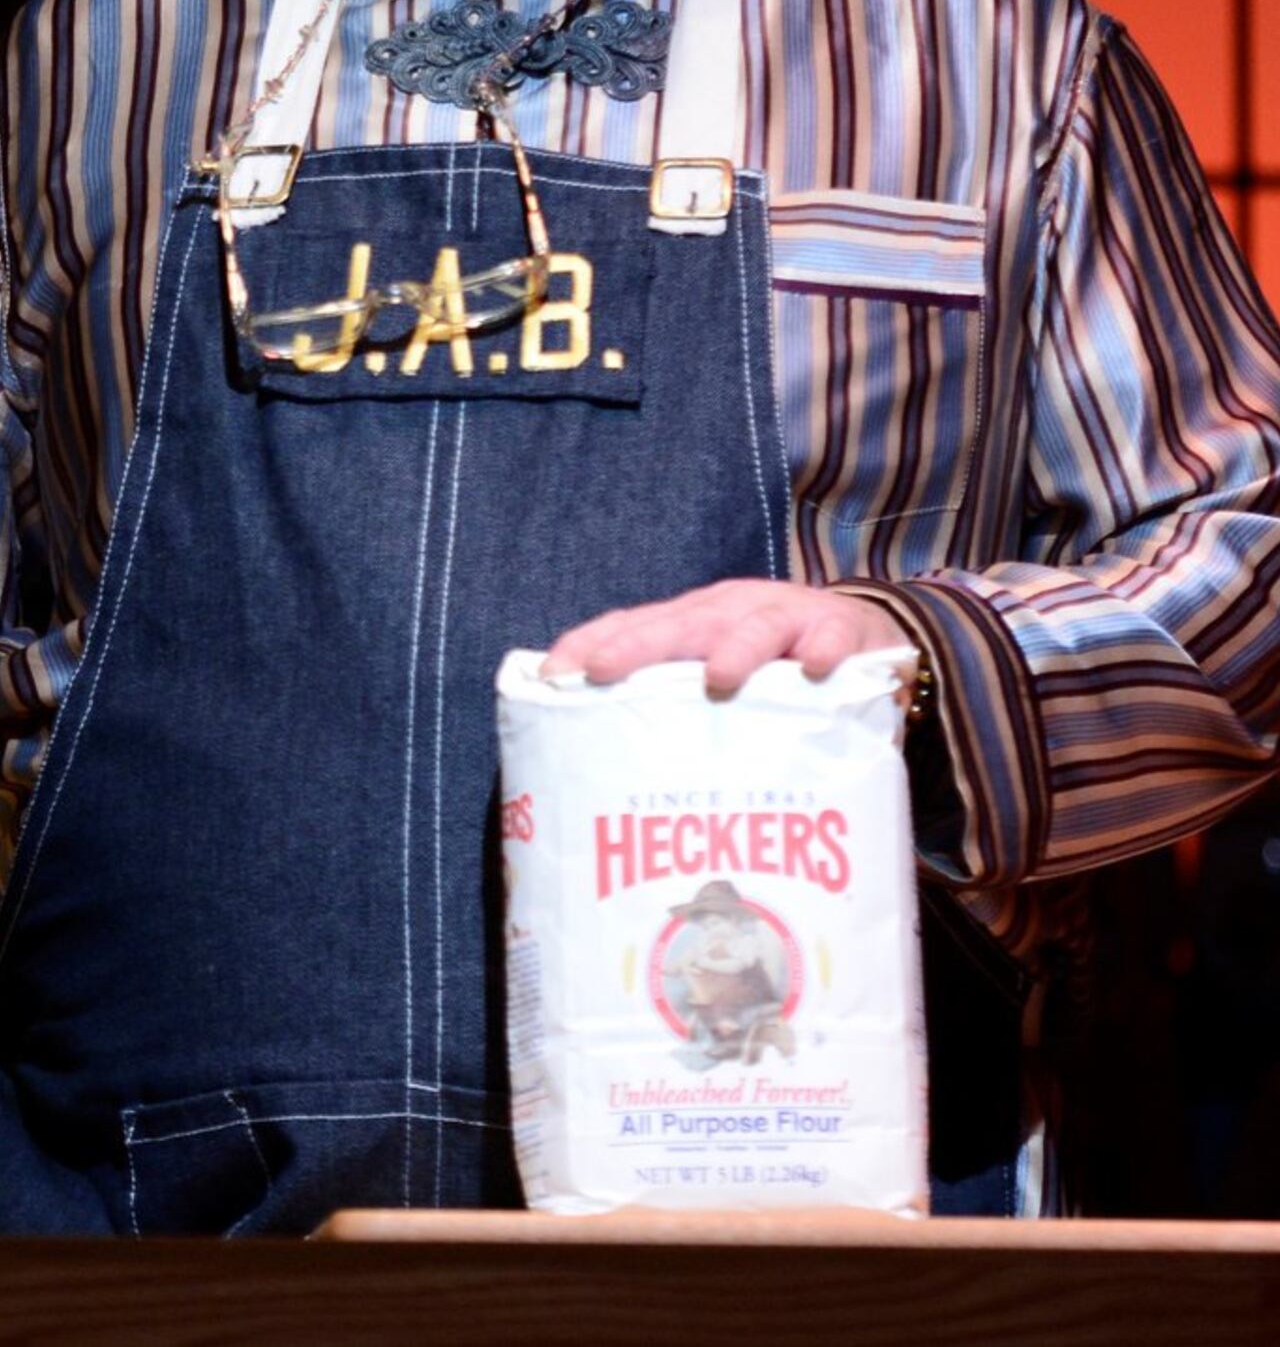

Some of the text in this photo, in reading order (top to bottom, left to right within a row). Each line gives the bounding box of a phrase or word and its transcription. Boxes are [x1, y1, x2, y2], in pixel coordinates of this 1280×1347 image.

[290, 242, 624, 377] J.A.B.
[627, 791, 720, 810] SINCE
[595, 809, 851, 901] HECKERS
[608, 1077, 746, 1108] Unbleached
[620, 1109, 843, 1139] All Purpose Flour
[634, 1166, 673, 1185] NET
[677, 1165, 712, 1184] WT
[717, 1166, 727, 1183] 5
[731, 1165, 755, 1184] LB
